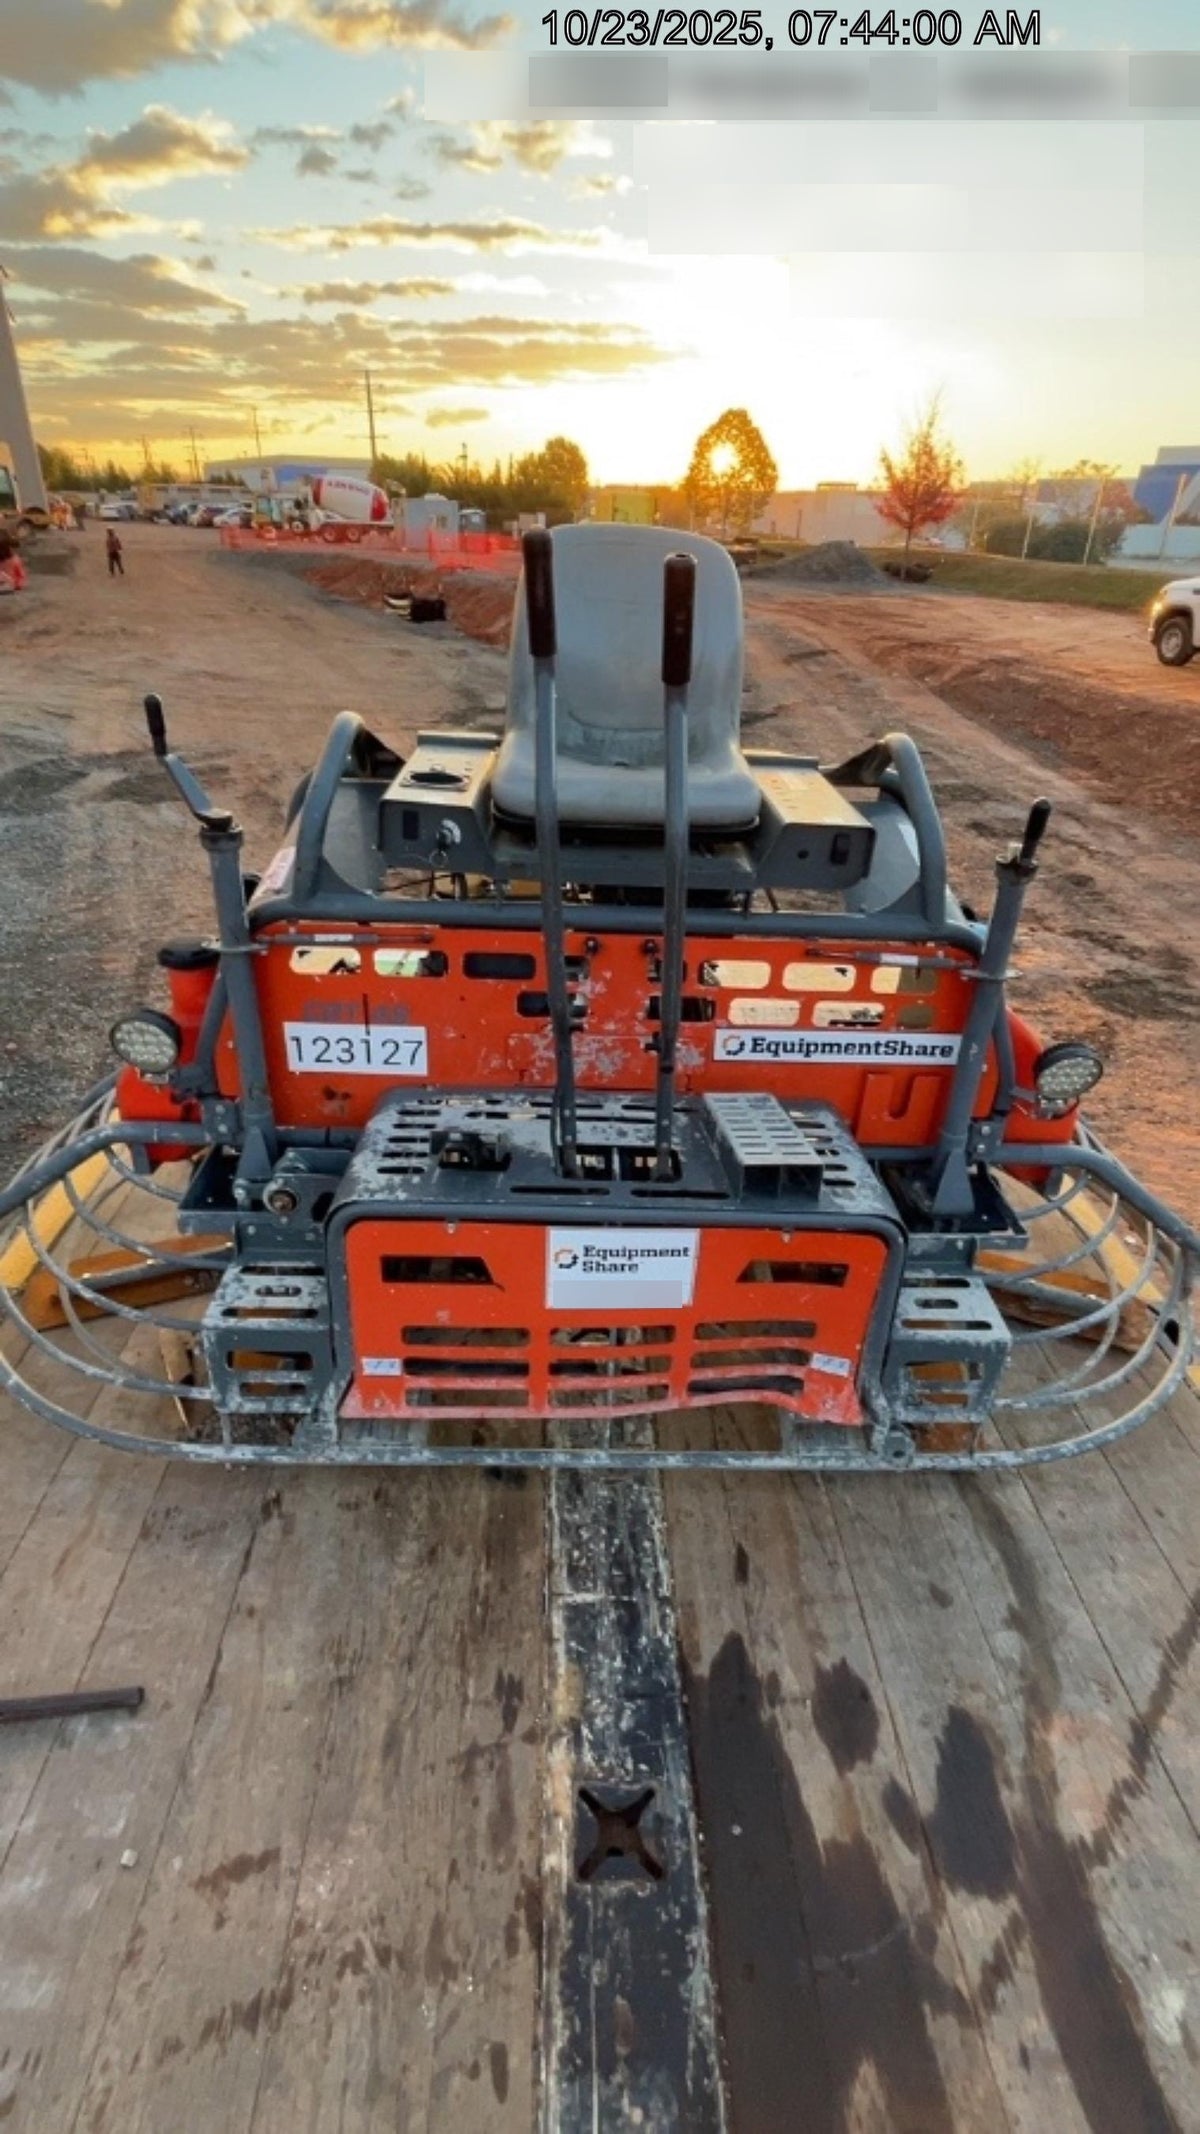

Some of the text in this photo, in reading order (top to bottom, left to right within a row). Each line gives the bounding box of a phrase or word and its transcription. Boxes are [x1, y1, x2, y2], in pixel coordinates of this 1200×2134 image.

[290, 1035, 423, 1067] 123127
[751, 1036, 954, 1059] EquipmentShare
[582, 1244, 690, 1261] Equipment
[582, 1260, 639, 1273] Share
